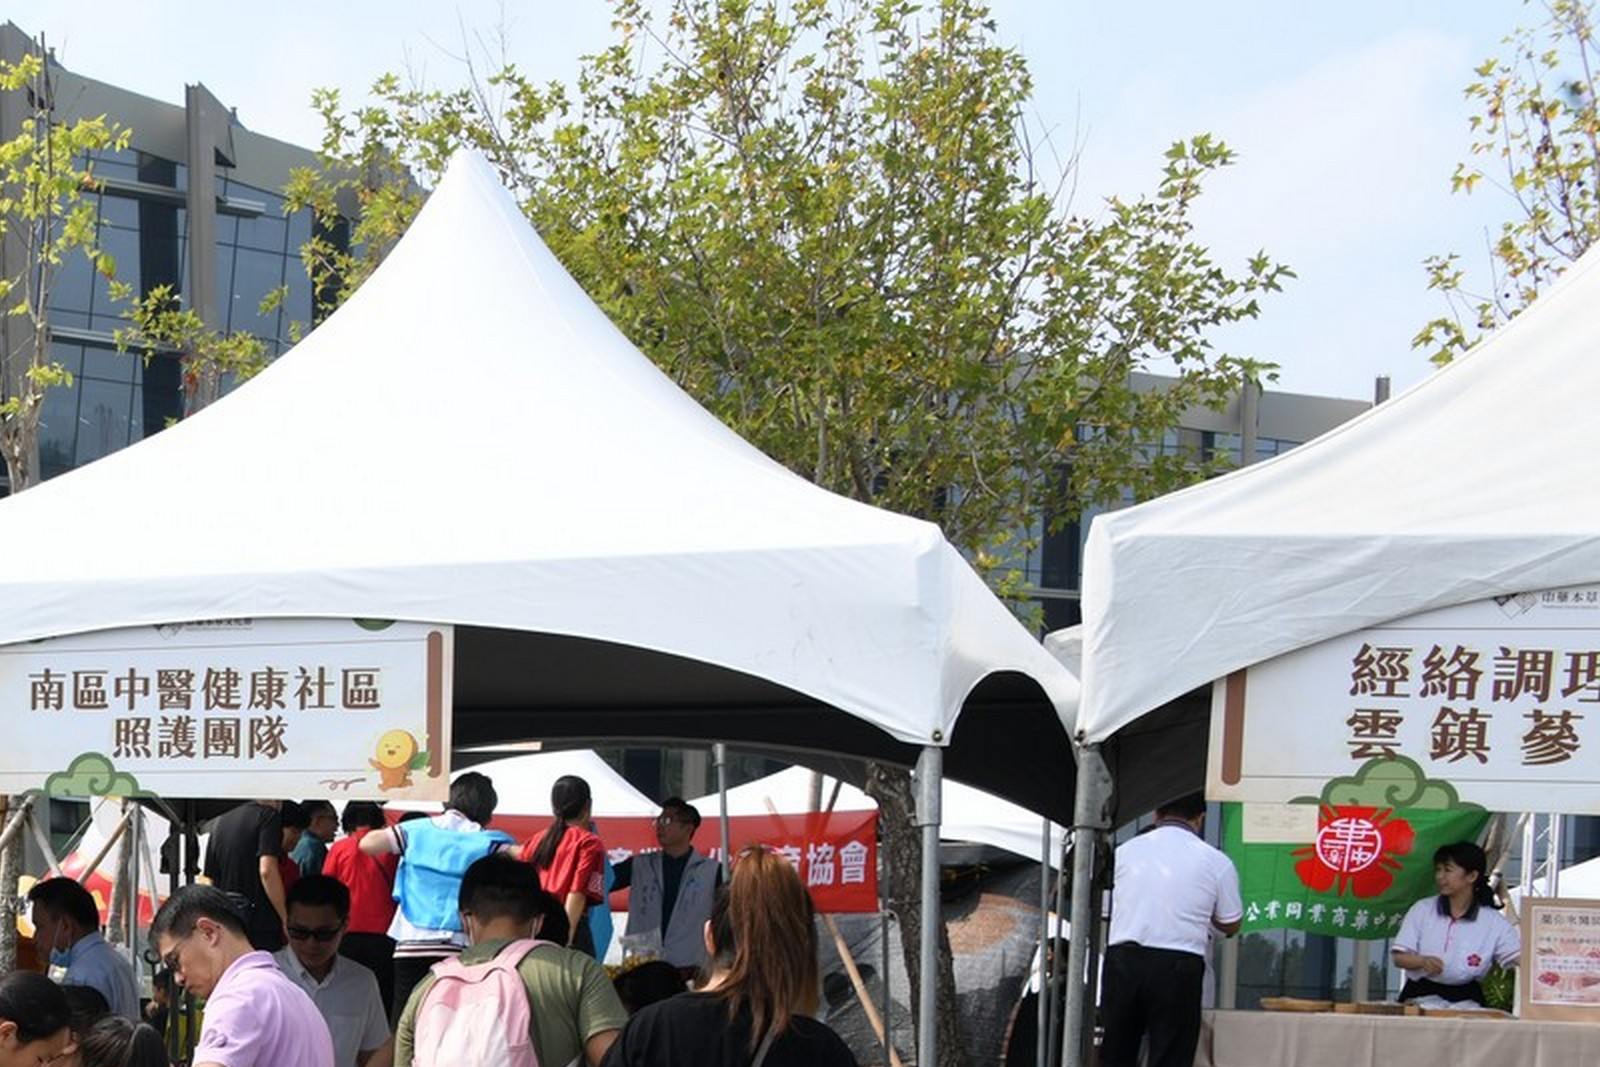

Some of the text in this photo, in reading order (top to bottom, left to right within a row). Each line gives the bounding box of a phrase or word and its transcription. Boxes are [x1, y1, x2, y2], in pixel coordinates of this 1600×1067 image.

[28, 665, 382, 712] 南區中醫健康社區
[1350, 643, 1600, 703] 經絡調理
[111, 716, 290, 760] 照護團隊
